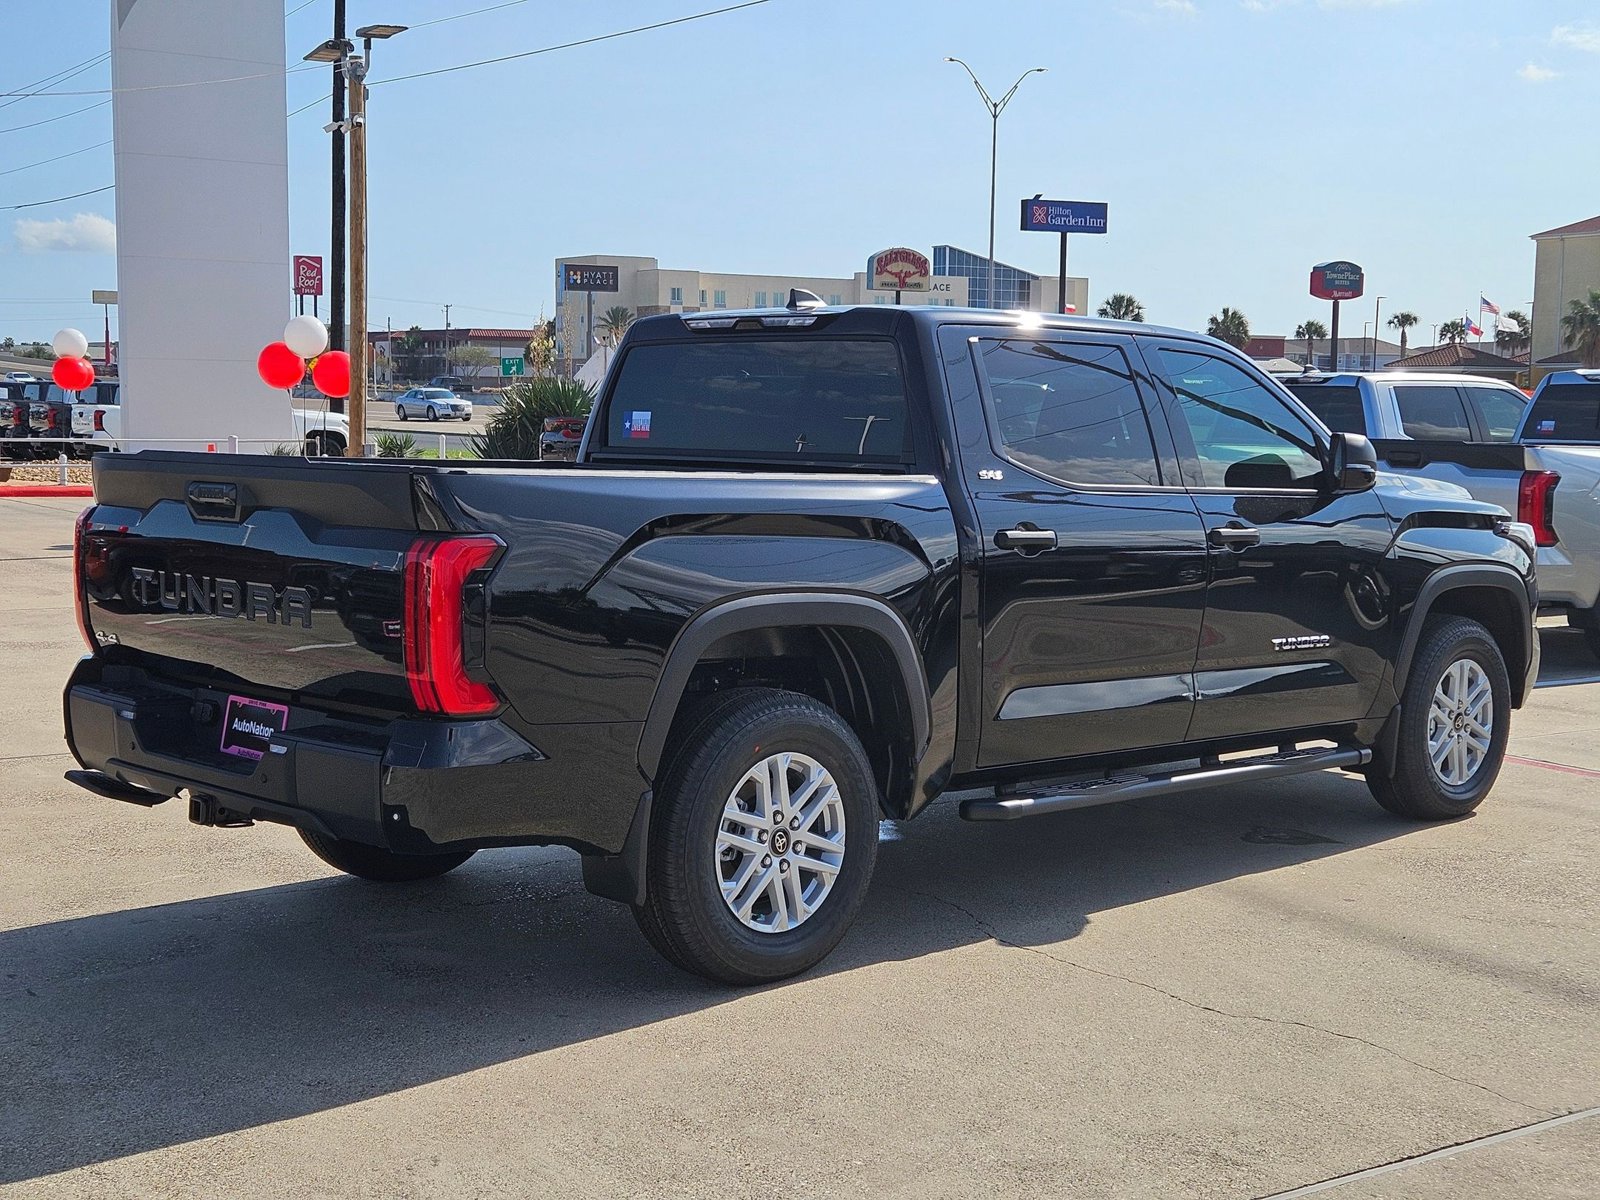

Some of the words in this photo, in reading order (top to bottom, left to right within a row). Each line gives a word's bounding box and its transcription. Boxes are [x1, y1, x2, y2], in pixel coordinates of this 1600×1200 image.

[1048, 206, 1072, 215] Hilton
[1047, 214, 1085, 226] Garden
[1086, 215, 1104, 227] Inn
[300, 265, 317, 277] Red
[583, 271, 614, 279] HYATT
[1325, 270, 1360, 281] TownePlace
[299, 276, 321, 289] Roof
[131, 566, 312, 629] TUNDRA
[1271, 635, 1330, 650] TUNDRA
